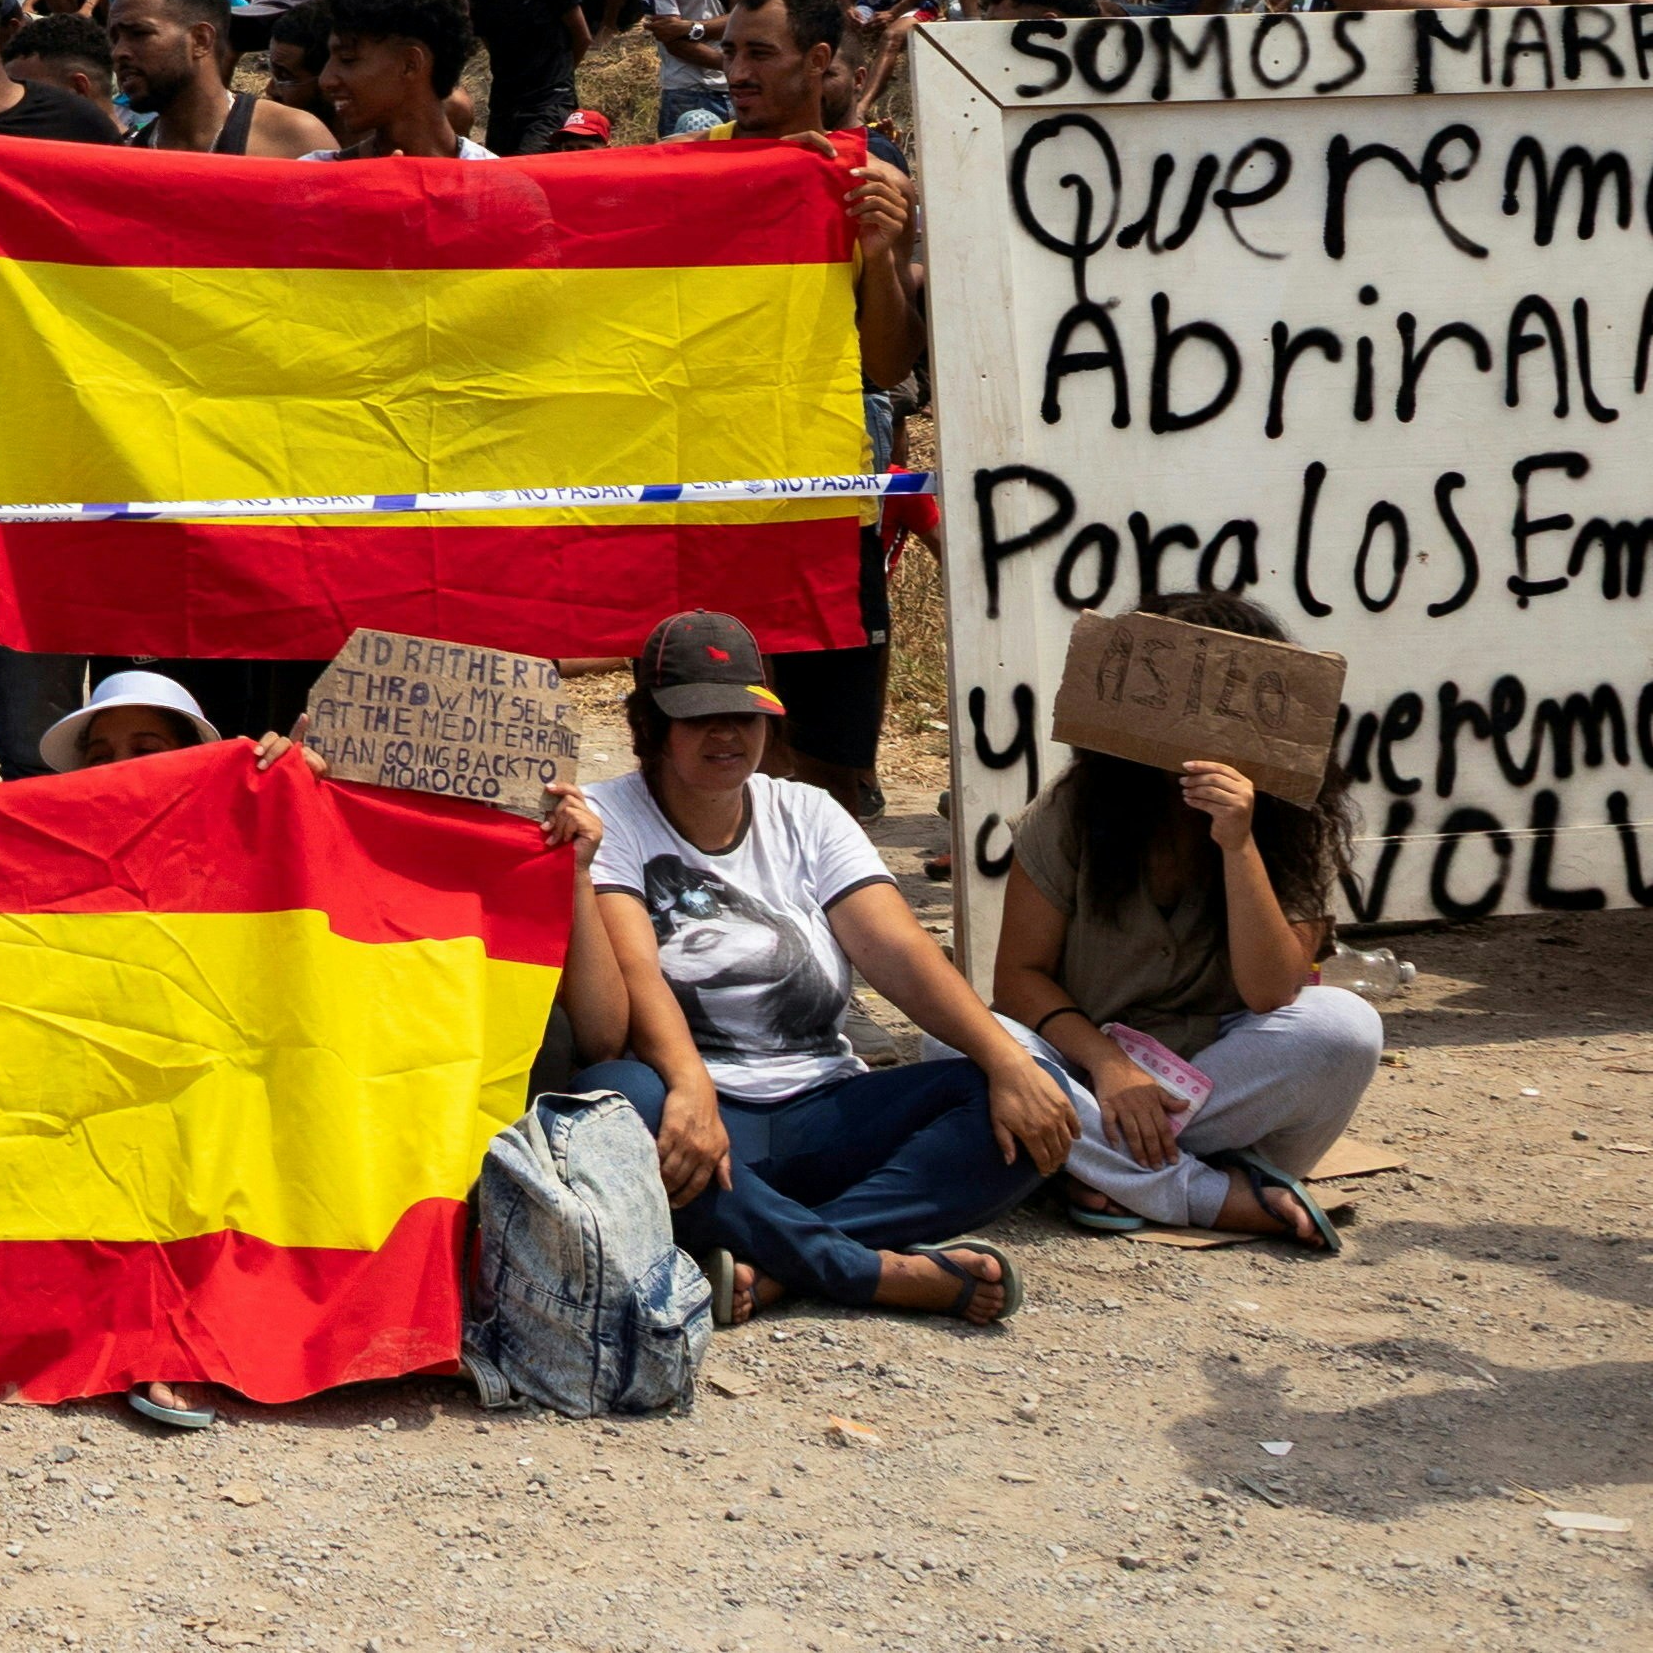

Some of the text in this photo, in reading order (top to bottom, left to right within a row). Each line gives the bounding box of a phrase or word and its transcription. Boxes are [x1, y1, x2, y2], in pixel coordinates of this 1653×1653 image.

[1009, 11, 1367, 102] SOMOS
[1009, 113, 1653, 308] Querem
[358, 633, 561, 690] I'D RATHER TO
[315, 698, 354, 729] AT
[359, 703, 413, 737] THE
[336, 667, 463, 712] THROW
[469, 685, 505, 718] MY
[304, 735, 376, 765] THAN
[383, 740, 451, 769] GOING
[378, 763, 501, 798] MOROCCO
